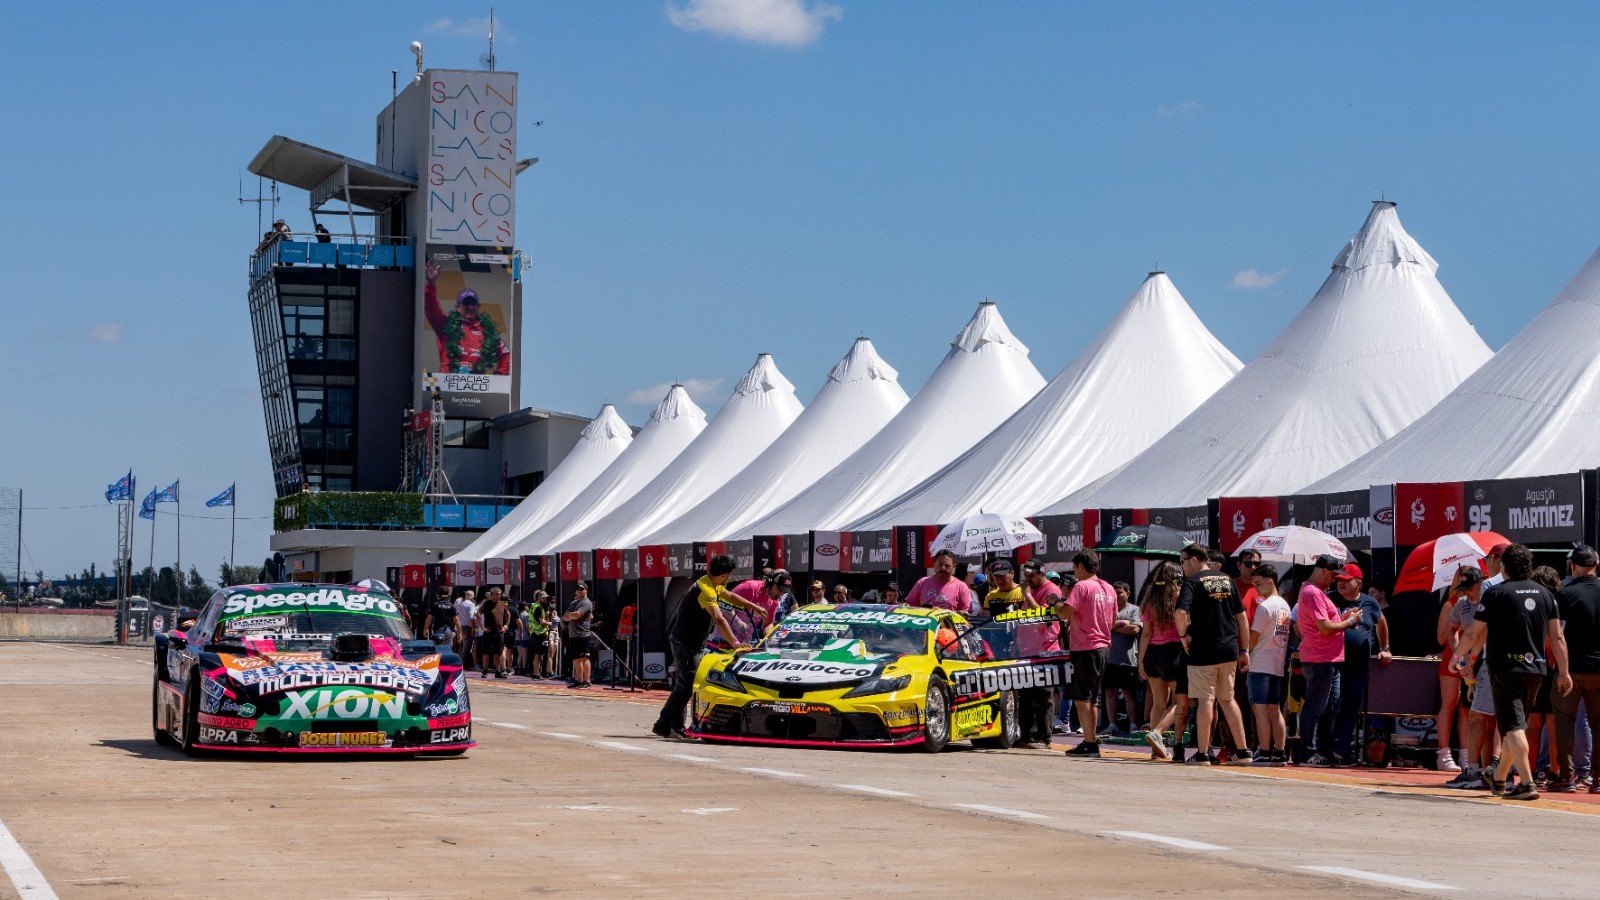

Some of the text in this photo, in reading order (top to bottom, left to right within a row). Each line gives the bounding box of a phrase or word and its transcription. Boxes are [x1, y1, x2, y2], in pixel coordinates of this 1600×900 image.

[431, 81, 514, 106] SAN
[430, 164, 512, 189] SAN
[444, 375, 490, 384] ¡GRACIAS
[1329, 504, 1354, 516] Jonatan
[1469, 505, 1491, 532] 95
[223, 588, 399, 614] SpeedAgro
[784, 610, 932, 626] SpeedAgro
[765, 660, 872, 678] Maiocco
[981, 661, 1075, 693] DOWEN P
[258, 672, 425, 696] MULTIBANDAS
[279, 689, 406, 720] XION
[224, 718, 250, 728] AGRO
[301, 732, 336, 745] JOSE
